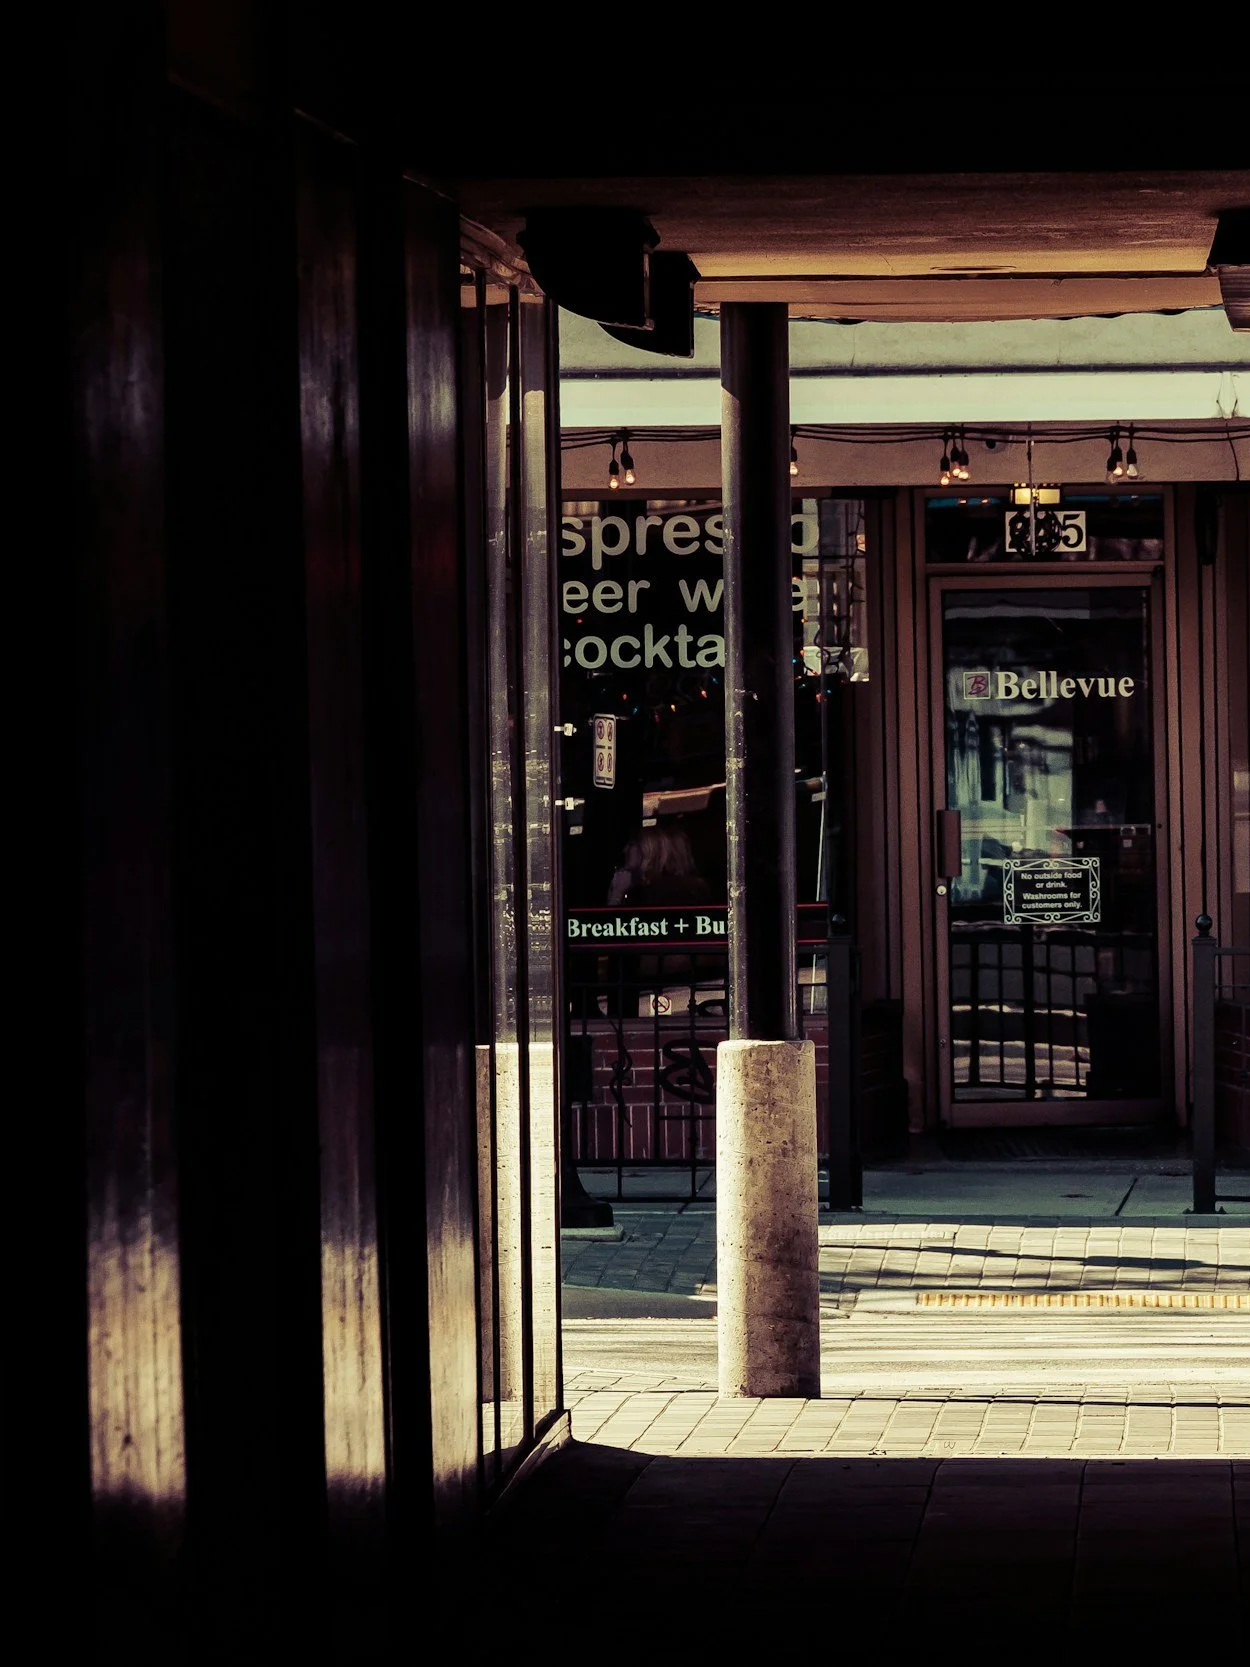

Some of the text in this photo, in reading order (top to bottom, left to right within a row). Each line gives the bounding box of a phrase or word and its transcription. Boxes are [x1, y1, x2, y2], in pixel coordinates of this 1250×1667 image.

[563, 580, 650, 613] eer
[995, 671, 1135, 699] Bellevue
[1064, 901, 1082, 909] only.
[568, 917, 668, 937] Breakfast
[674, 918, 689, 933] +
